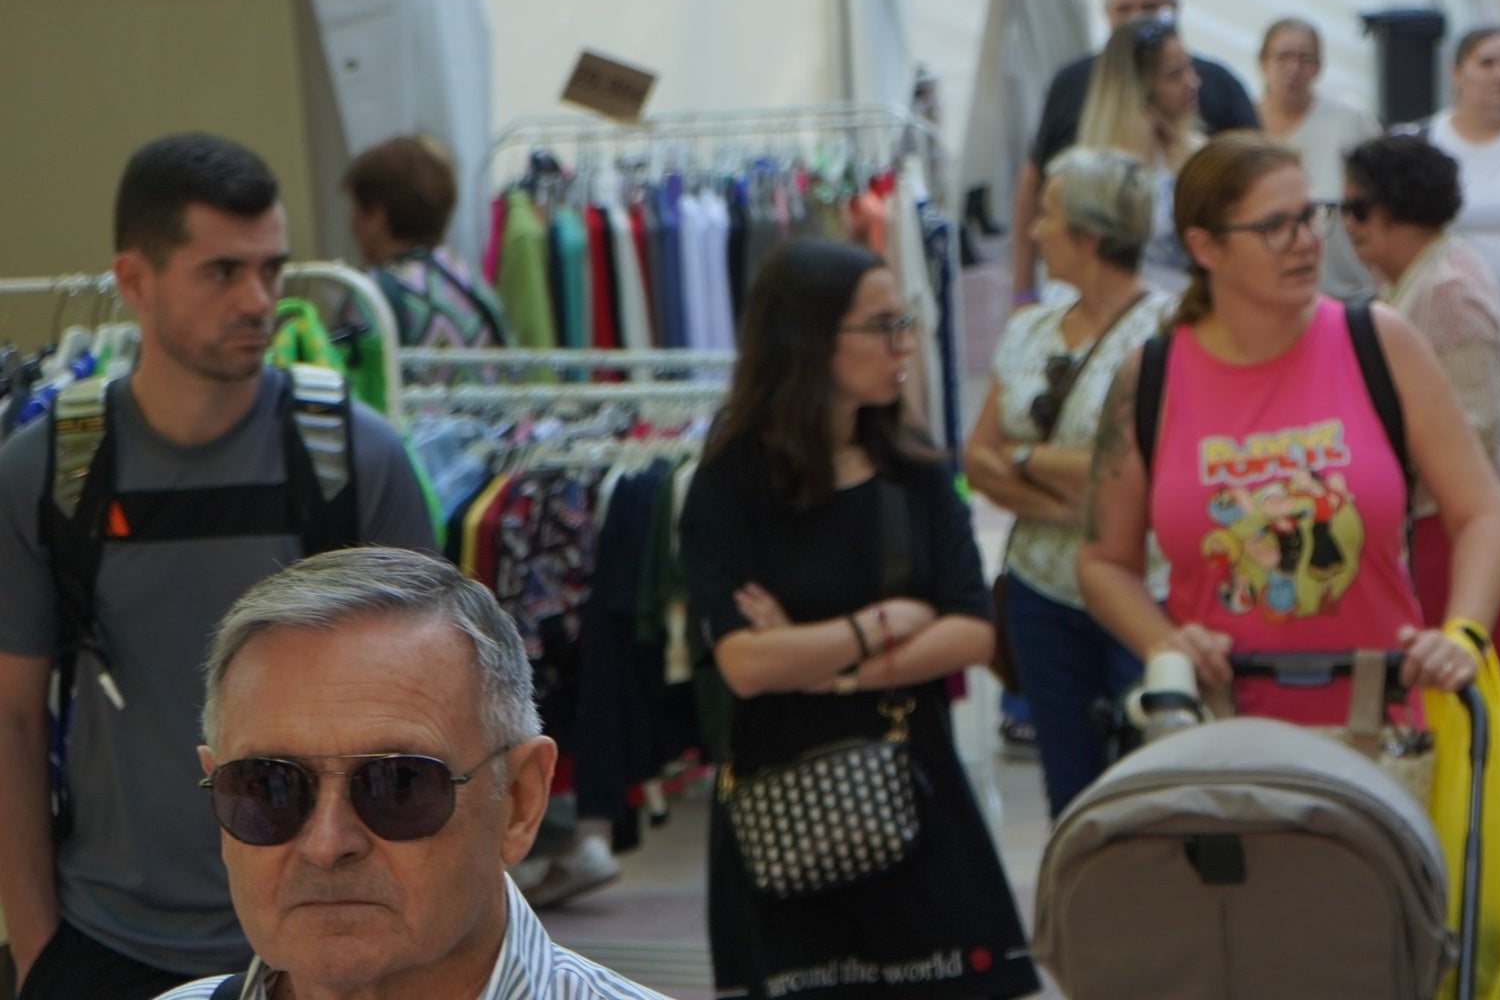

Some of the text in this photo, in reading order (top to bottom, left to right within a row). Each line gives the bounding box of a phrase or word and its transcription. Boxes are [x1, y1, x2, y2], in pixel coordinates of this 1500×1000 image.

[1203, 422, 1346, 481] POPEYE
[764, 949, 964, 998] around the world
